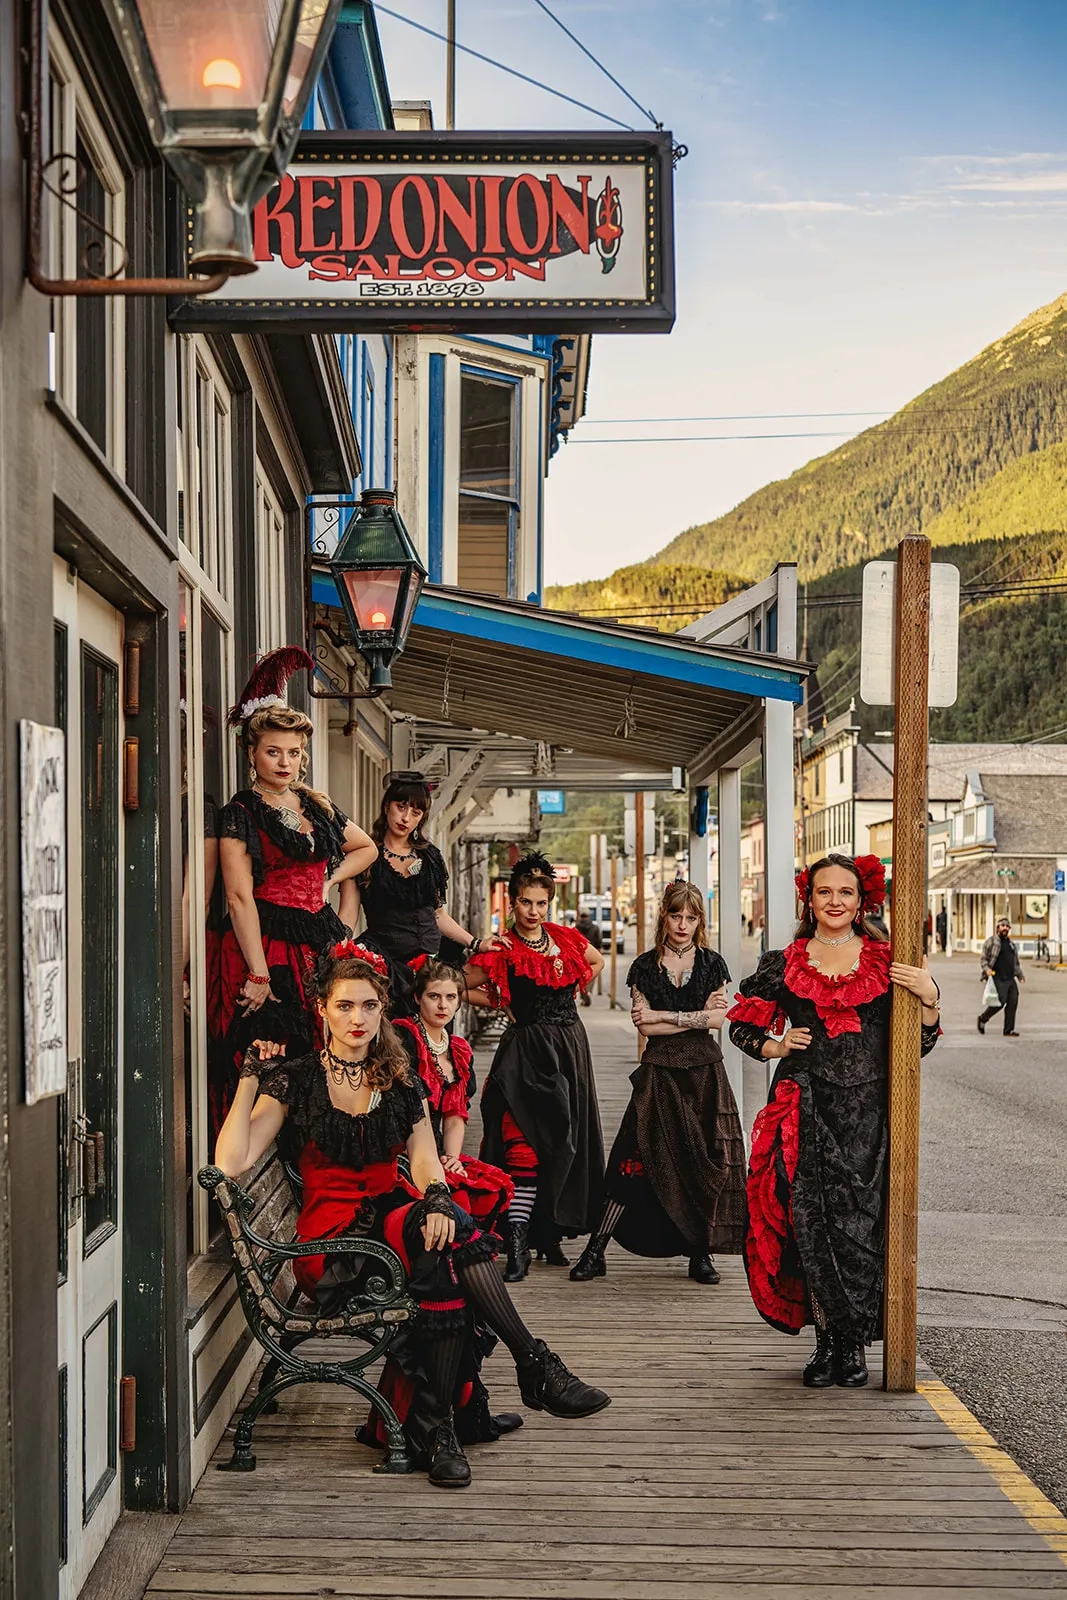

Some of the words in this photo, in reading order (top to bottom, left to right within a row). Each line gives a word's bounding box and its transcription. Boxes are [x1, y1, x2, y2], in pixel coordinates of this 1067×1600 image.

[252, 172, 383, 269] RED
[389, 173, 593, 260] ONION
[308, 254, 548, 282] SALOON
[360, 283, 413, 296] EST.
[416, 282, 485, 298] 1898
